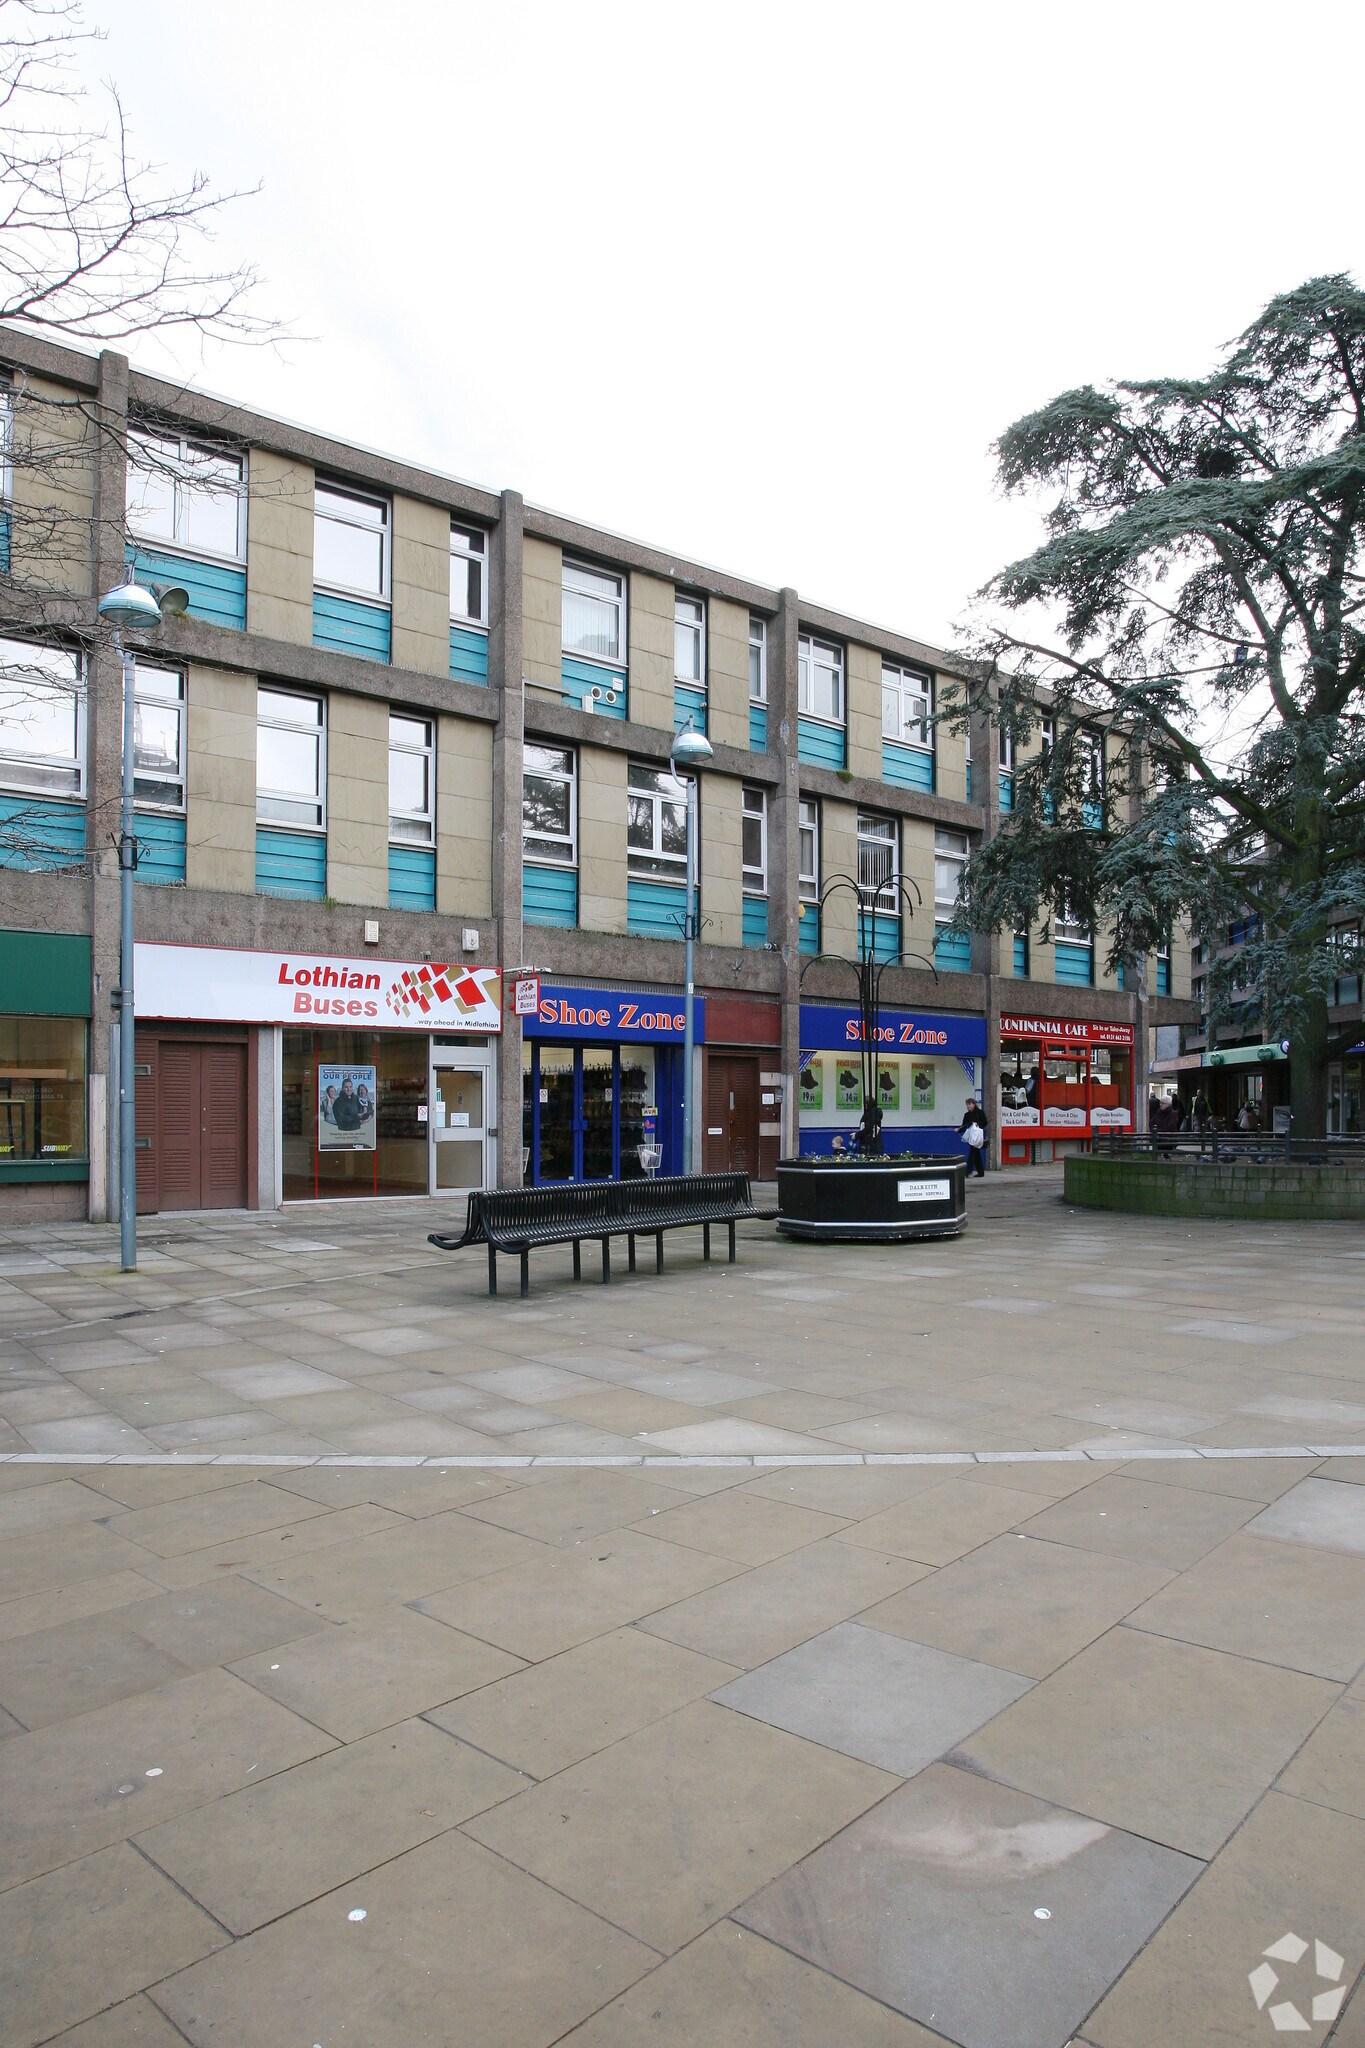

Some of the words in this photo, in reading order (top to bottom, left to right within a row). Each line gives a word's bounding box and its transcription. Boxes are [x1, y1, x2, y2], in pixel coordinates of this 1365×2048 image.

[278, 963, 381, 990] Lothian
[294, 992, 378, 1017] Buses
[540, 998, 610, 1026] Shoe
[618, 1004, 686, 1030] Zone
[464, 1020, 499, 1028] Midlothian
[899, 1023, 948, 1044] Zone
[1000, 1018, 1062, 1034] CONTINENTAL
[1064, 1023, 1088, 1036] CAFE
